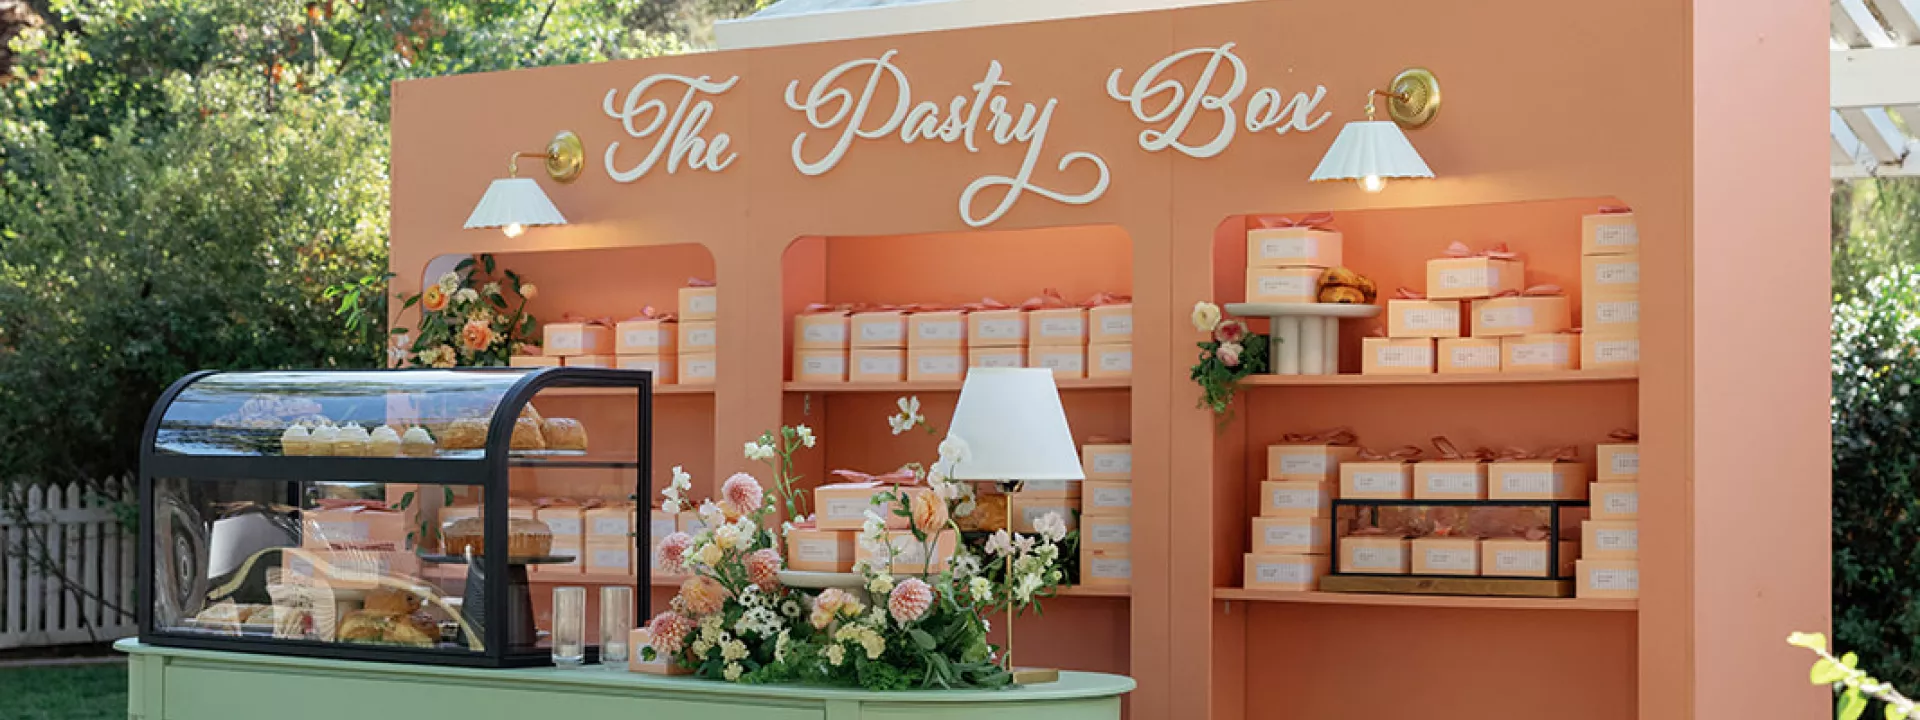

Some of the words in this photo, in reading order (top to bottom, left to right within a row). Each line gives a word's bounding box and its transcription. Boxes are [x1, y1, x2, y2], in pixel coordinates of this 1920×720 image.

[603, 73, 740, 183] The
[784, 48, 1110, 227] Pastry
[1106, 41, 1332, 158] Box
